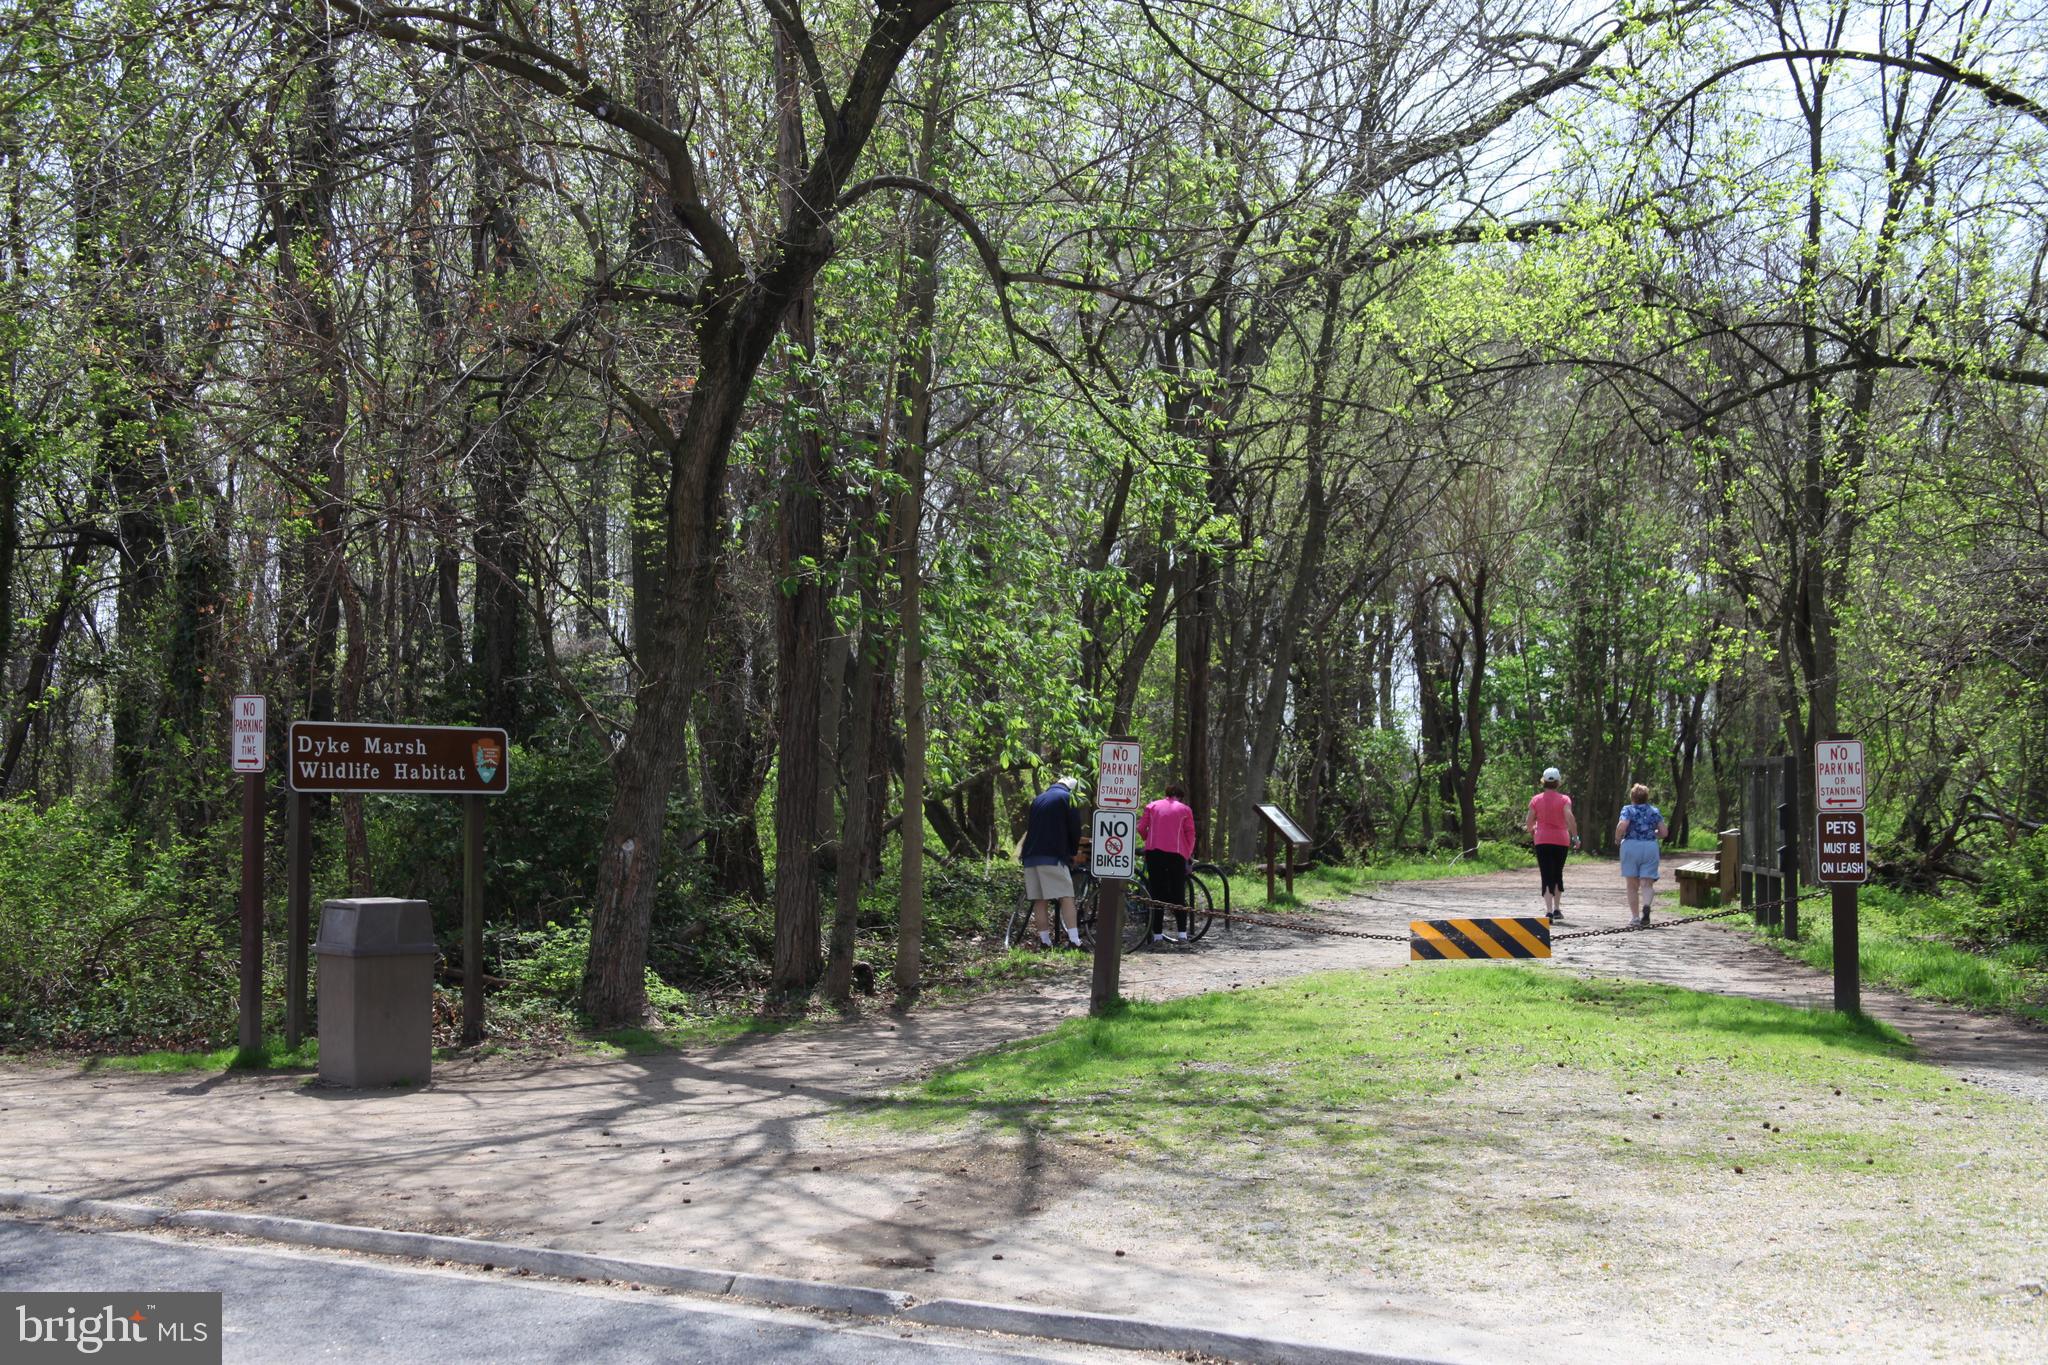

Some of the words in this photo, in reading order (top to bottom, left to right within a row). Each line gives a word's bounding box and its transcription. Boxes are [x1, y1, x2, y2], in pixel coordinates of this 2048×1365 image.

[243, 702, 256, 716] NO
[235, 719, 263, 733] PARKING
[242, 735, 256, 744] ANY
[297, 735, 350, 757] Dyke
[364, 737, 428, 755] Marsh
[241, 746, 256, 755] TIME
[1112, 749, 1129, 761] NO
[1830, 747, 1848, 760] NO
[298, 761, 380, 779] Wildlife
[394, 763, 466, 780] Habitat
[1102, 762, 1138, 776] PARKING
[1819, 761, 1861, 775] PARKING
[1114, 777, 1124, 785] OR
[1834, 777, 1846, 785] OR
[1101, 785, 1137, 796] STANDING
[1820, 786, 1861, 796] STANDING
[1100, 821, 1128, 838] NO
[1826, 821, 1857, 835] PETS
[1823, 842, 1847, 854] MUST
[1850, 842, 1861, 854] BE
[1096, 854, 1129, 868] BIKES
[1821, 862, 1834, 874] ON
[1836, 862, 1864, 874] LEASH
